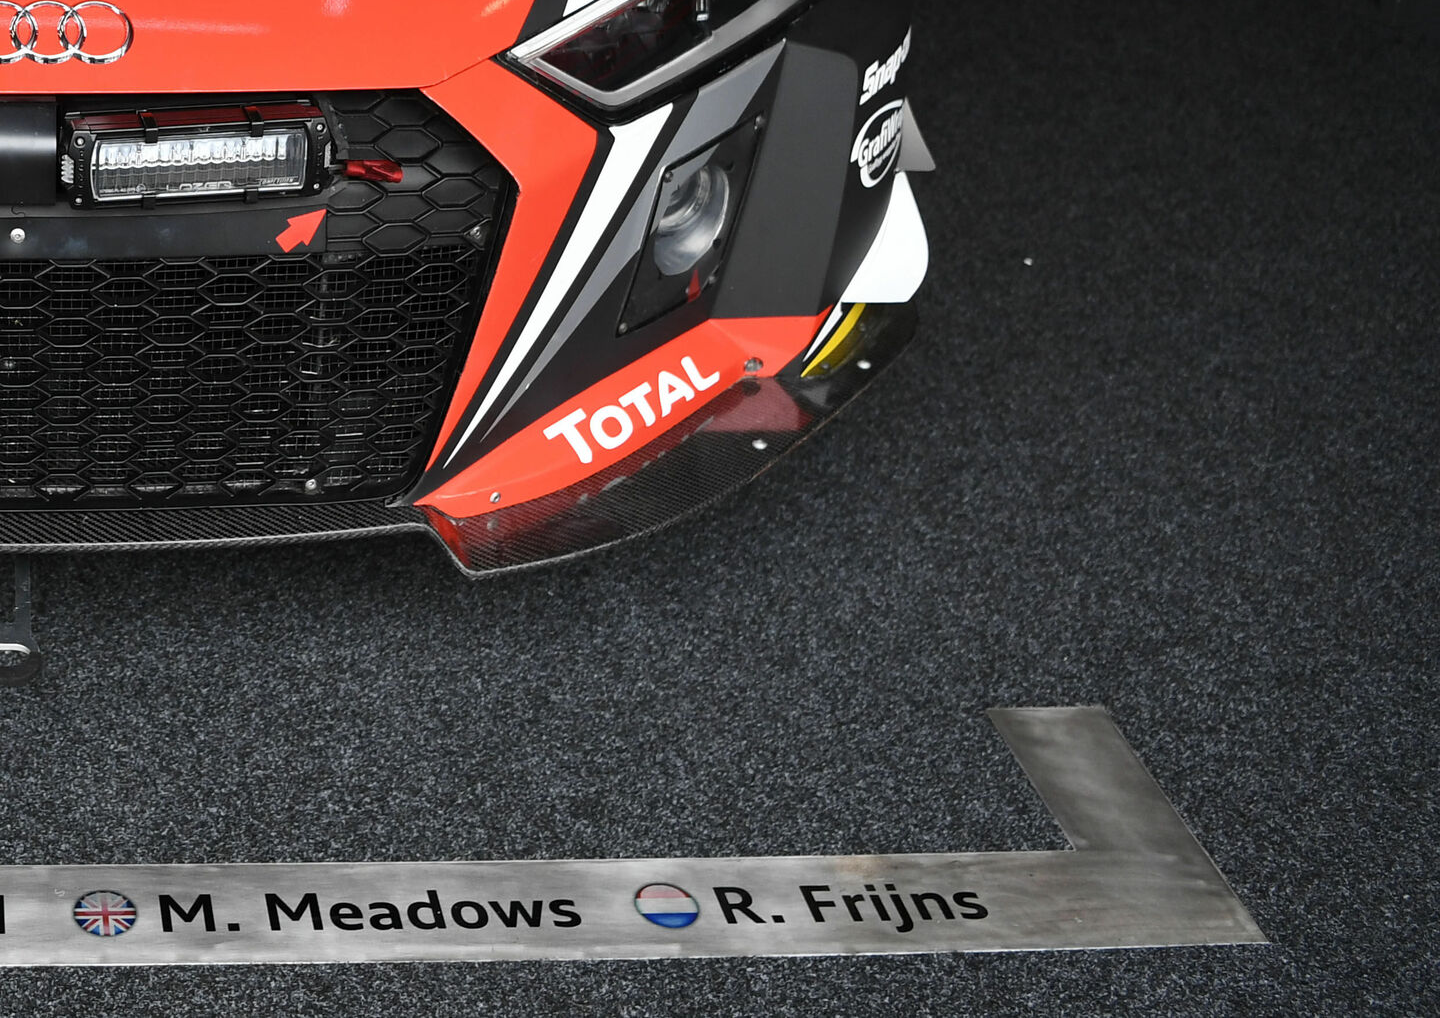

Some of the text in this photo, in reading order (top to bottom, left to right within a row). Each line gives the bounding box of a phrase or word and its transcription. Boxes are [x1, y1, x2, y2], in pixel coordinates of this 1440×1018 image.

[543, 356, 720, 463] TOTAL
[159, 890, 582, 932] M. Meadows
[712, 884, 989, 933] R. Frijns
